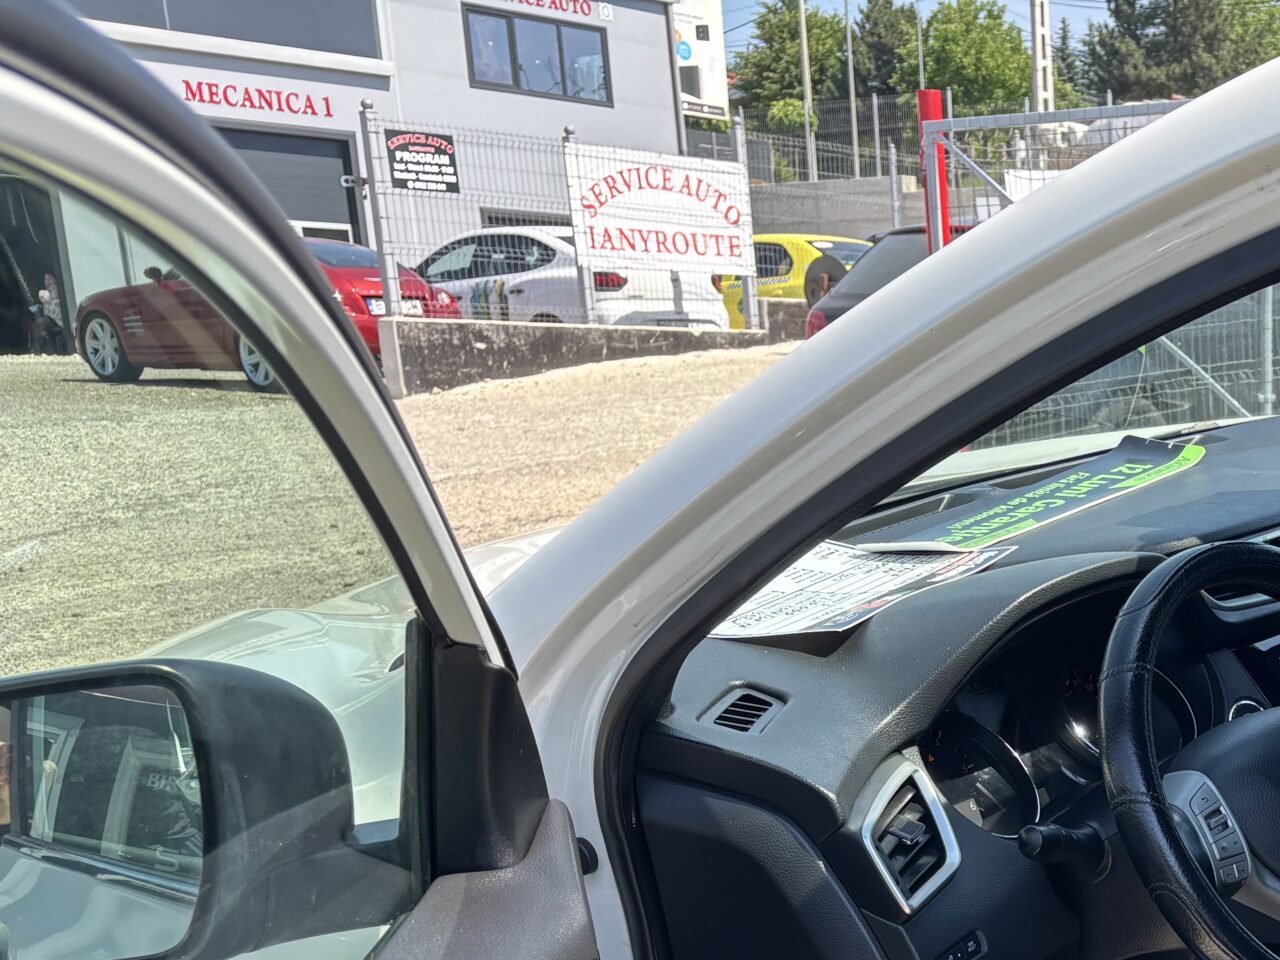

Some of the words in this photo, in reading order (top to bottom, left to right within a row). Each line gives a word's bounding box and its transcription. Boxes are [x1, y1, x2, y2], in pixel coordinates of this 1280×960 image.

[548, 0, 591, 16] AUTO
[182, 79, 318, 116] MECANICA
[322, 96, 333, 118] 1
[427, 135, 454, 154] AUTO
[395, 150, 450, 166] PROGRAM
[580, 165, 673, 218] SERVICE
[679, 174, 741, 226] AUTO
[588, 225, 742, 258] IANYROUTE
[1110, 463, 1154, 474] 12
[1054, 474, 1127, 498] Luni
